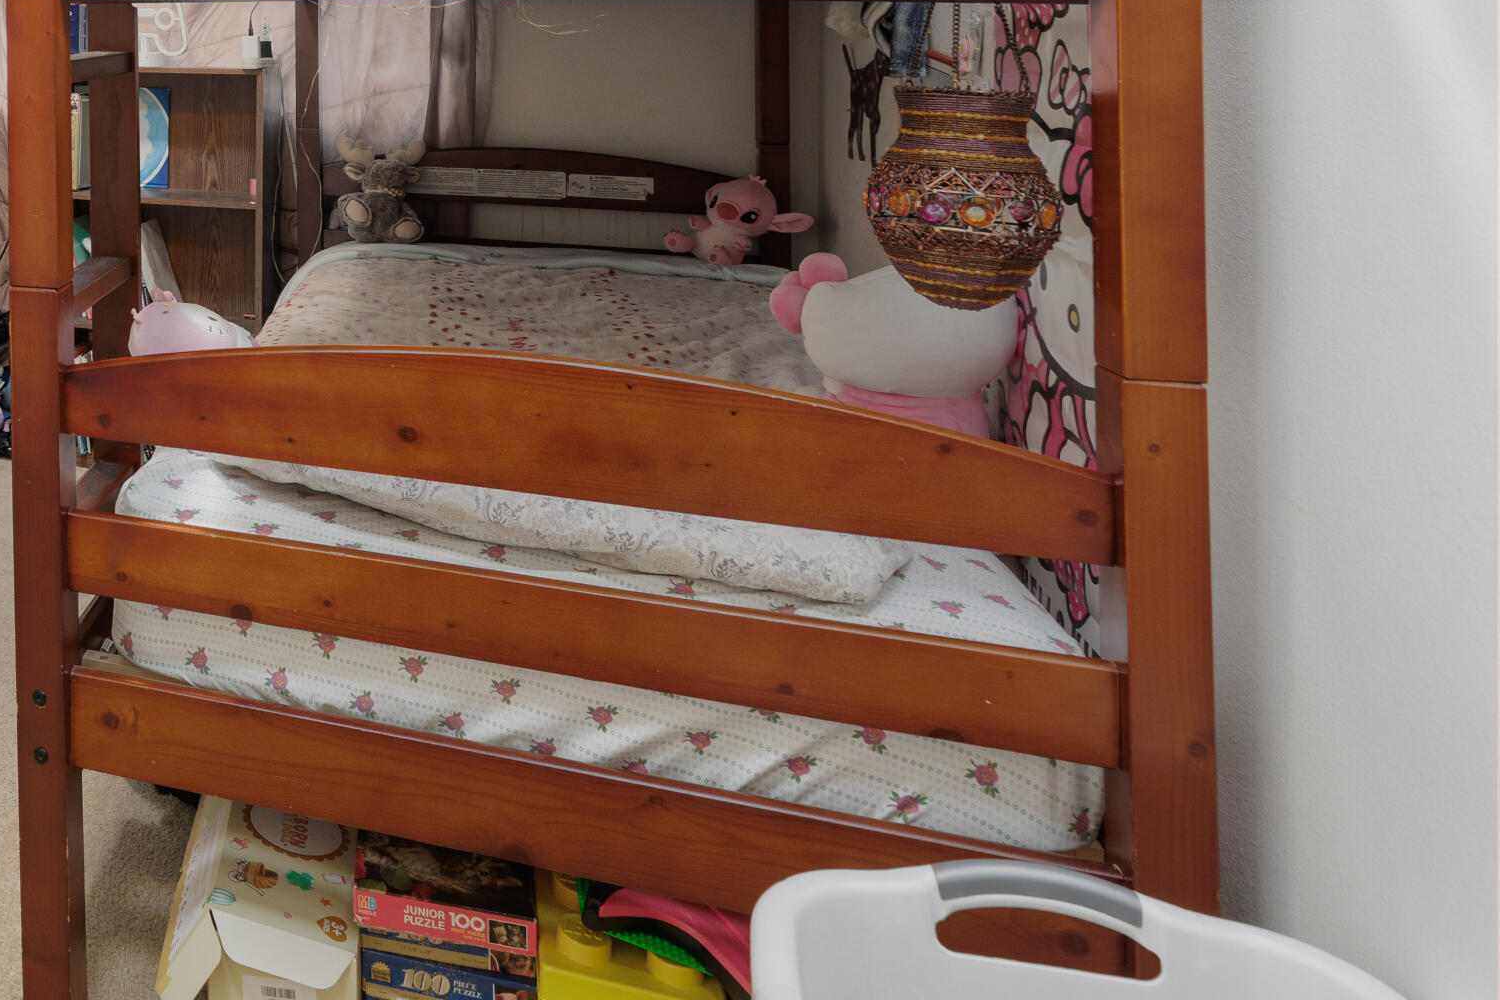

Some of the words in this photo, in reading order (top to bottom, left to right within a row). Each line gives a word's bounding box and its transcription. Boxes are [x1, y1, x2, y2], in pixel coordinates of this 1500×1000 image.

[358, 894, 377, 911] MB
[403, 904, 446, 921] JUNIOR
[403, 914, 446, 931] PUZZLE
[448, 911, 486, 932] 100
[400, 968, 451, 996] 100
[453, 979, 477, 991] PIECE
[453, 987, 483, 999] PUZZLE
